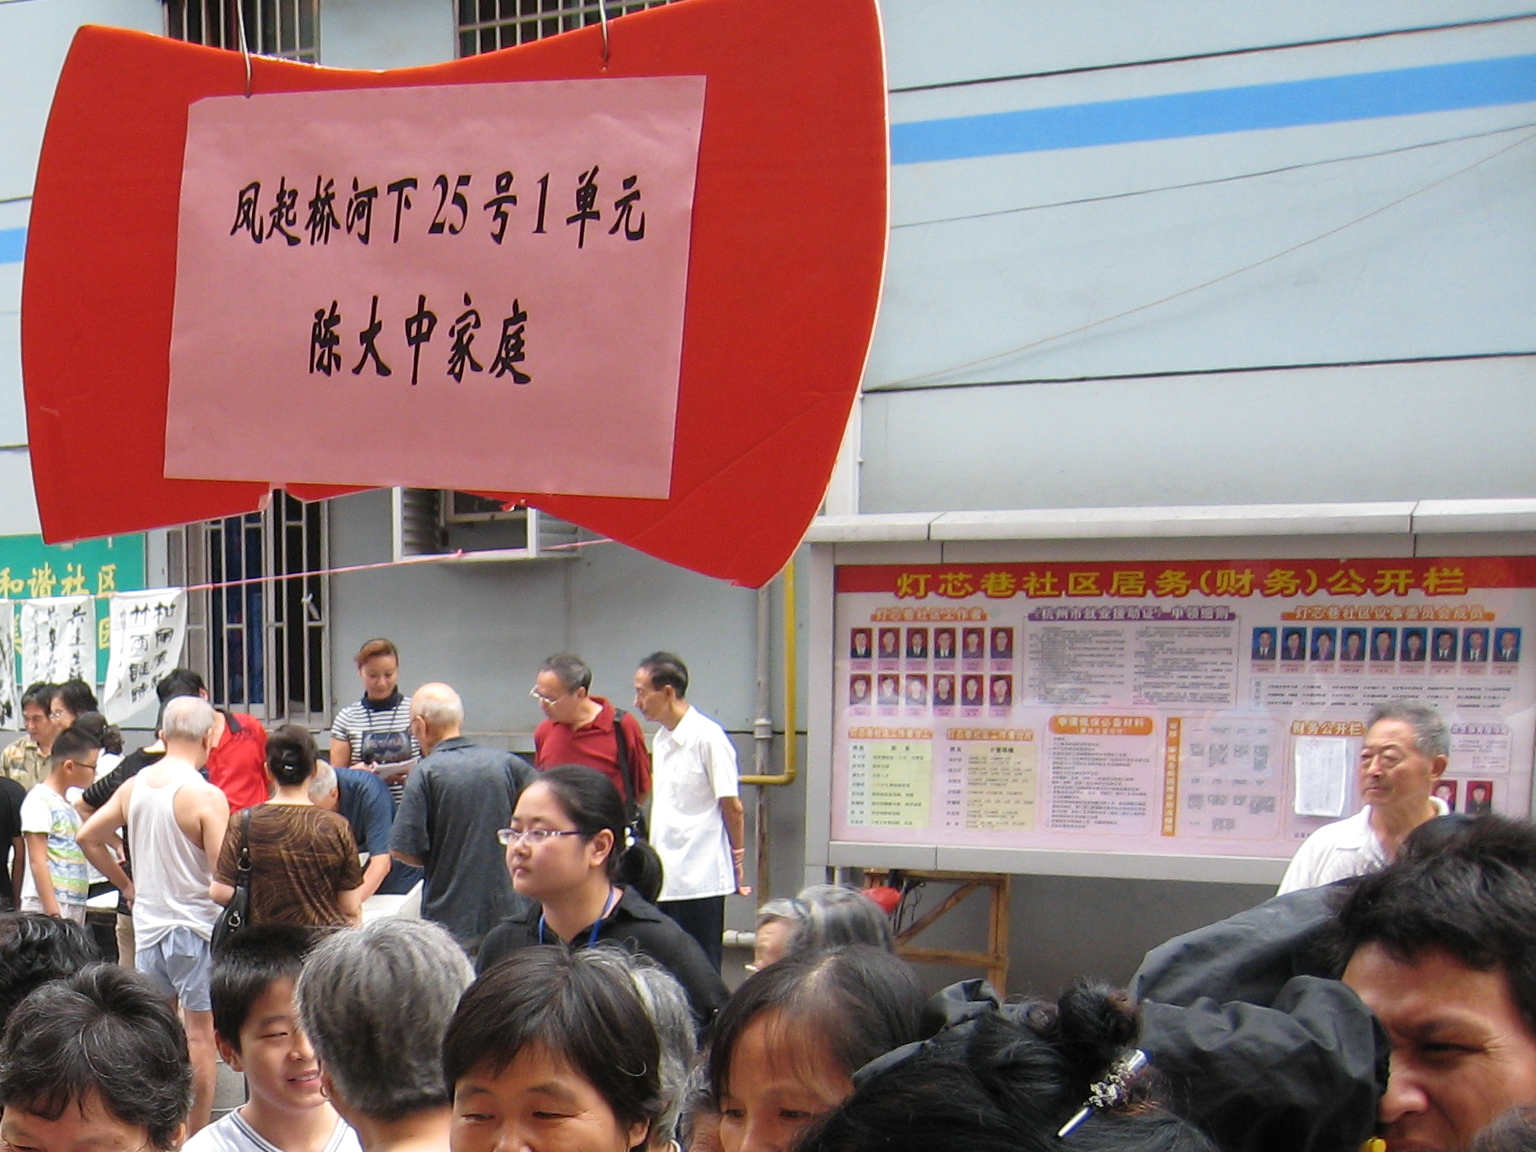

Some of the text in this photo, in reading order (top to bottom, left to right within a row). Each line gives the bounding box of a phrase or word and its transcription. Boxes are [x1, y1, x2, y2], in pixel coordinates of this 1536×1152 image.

[309, 293, 531, 385] 陈大中家庭
[1292, 721, 1362, 735] 财务公开栏
